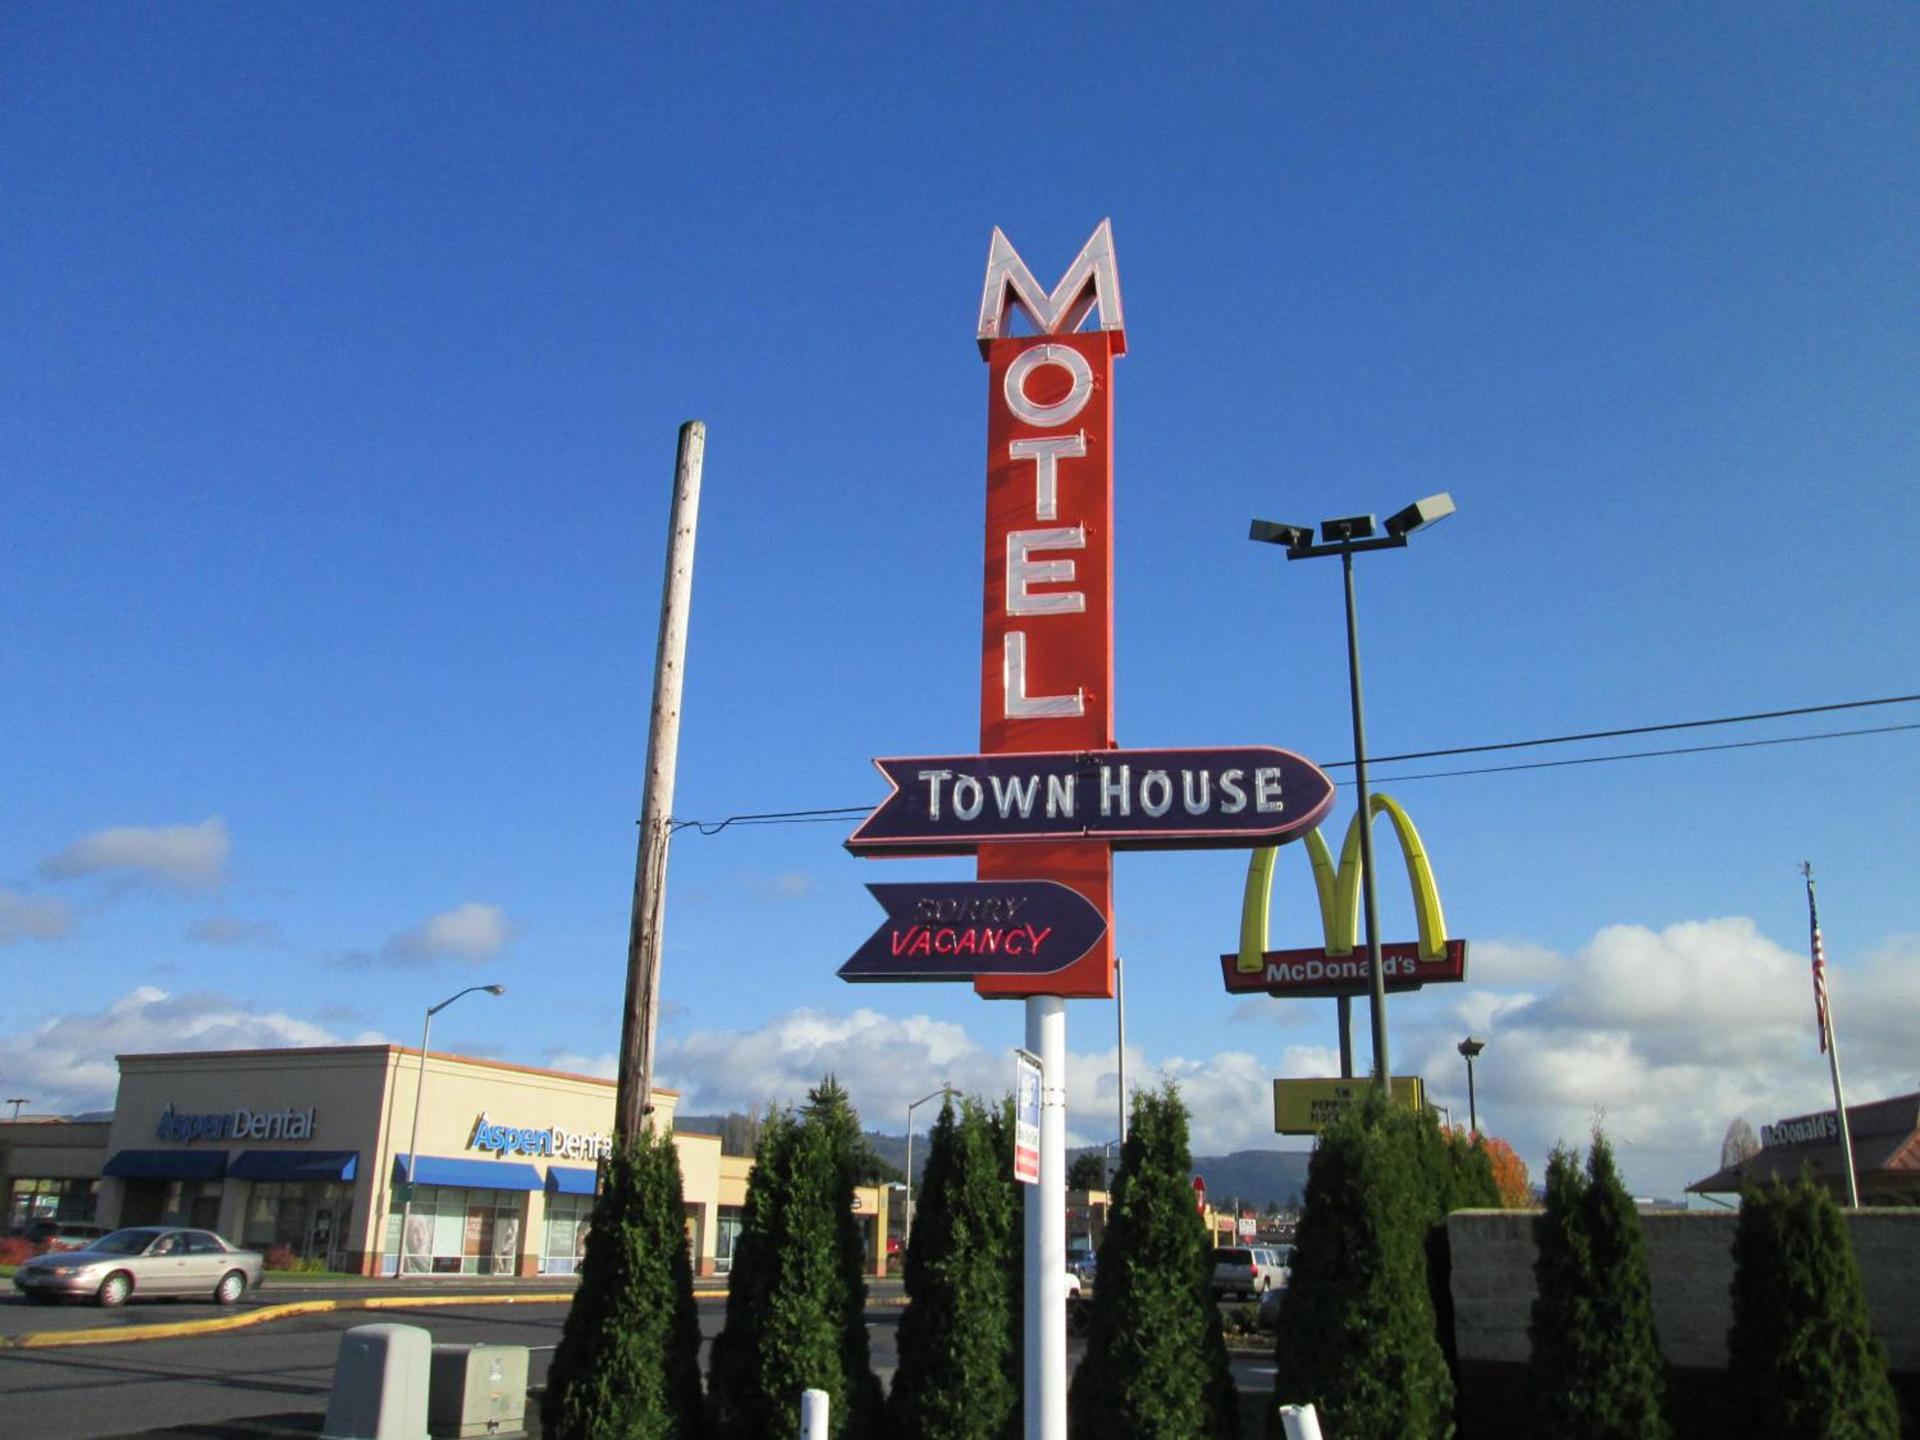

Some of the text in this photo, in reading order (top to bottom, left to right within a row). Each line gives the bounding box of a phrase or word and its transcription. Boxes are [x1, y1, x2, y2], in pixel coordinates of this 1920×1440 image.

[977, 215, 1124, 719] MOTEL
[918, 765, 1284, 821] TOWN HOUSE
[892, 924, 1051, 956] VACANCY
[1266, 955, 1417, 982] McDonad's
[1761, 1115, 1837, 1147] McDonald's
